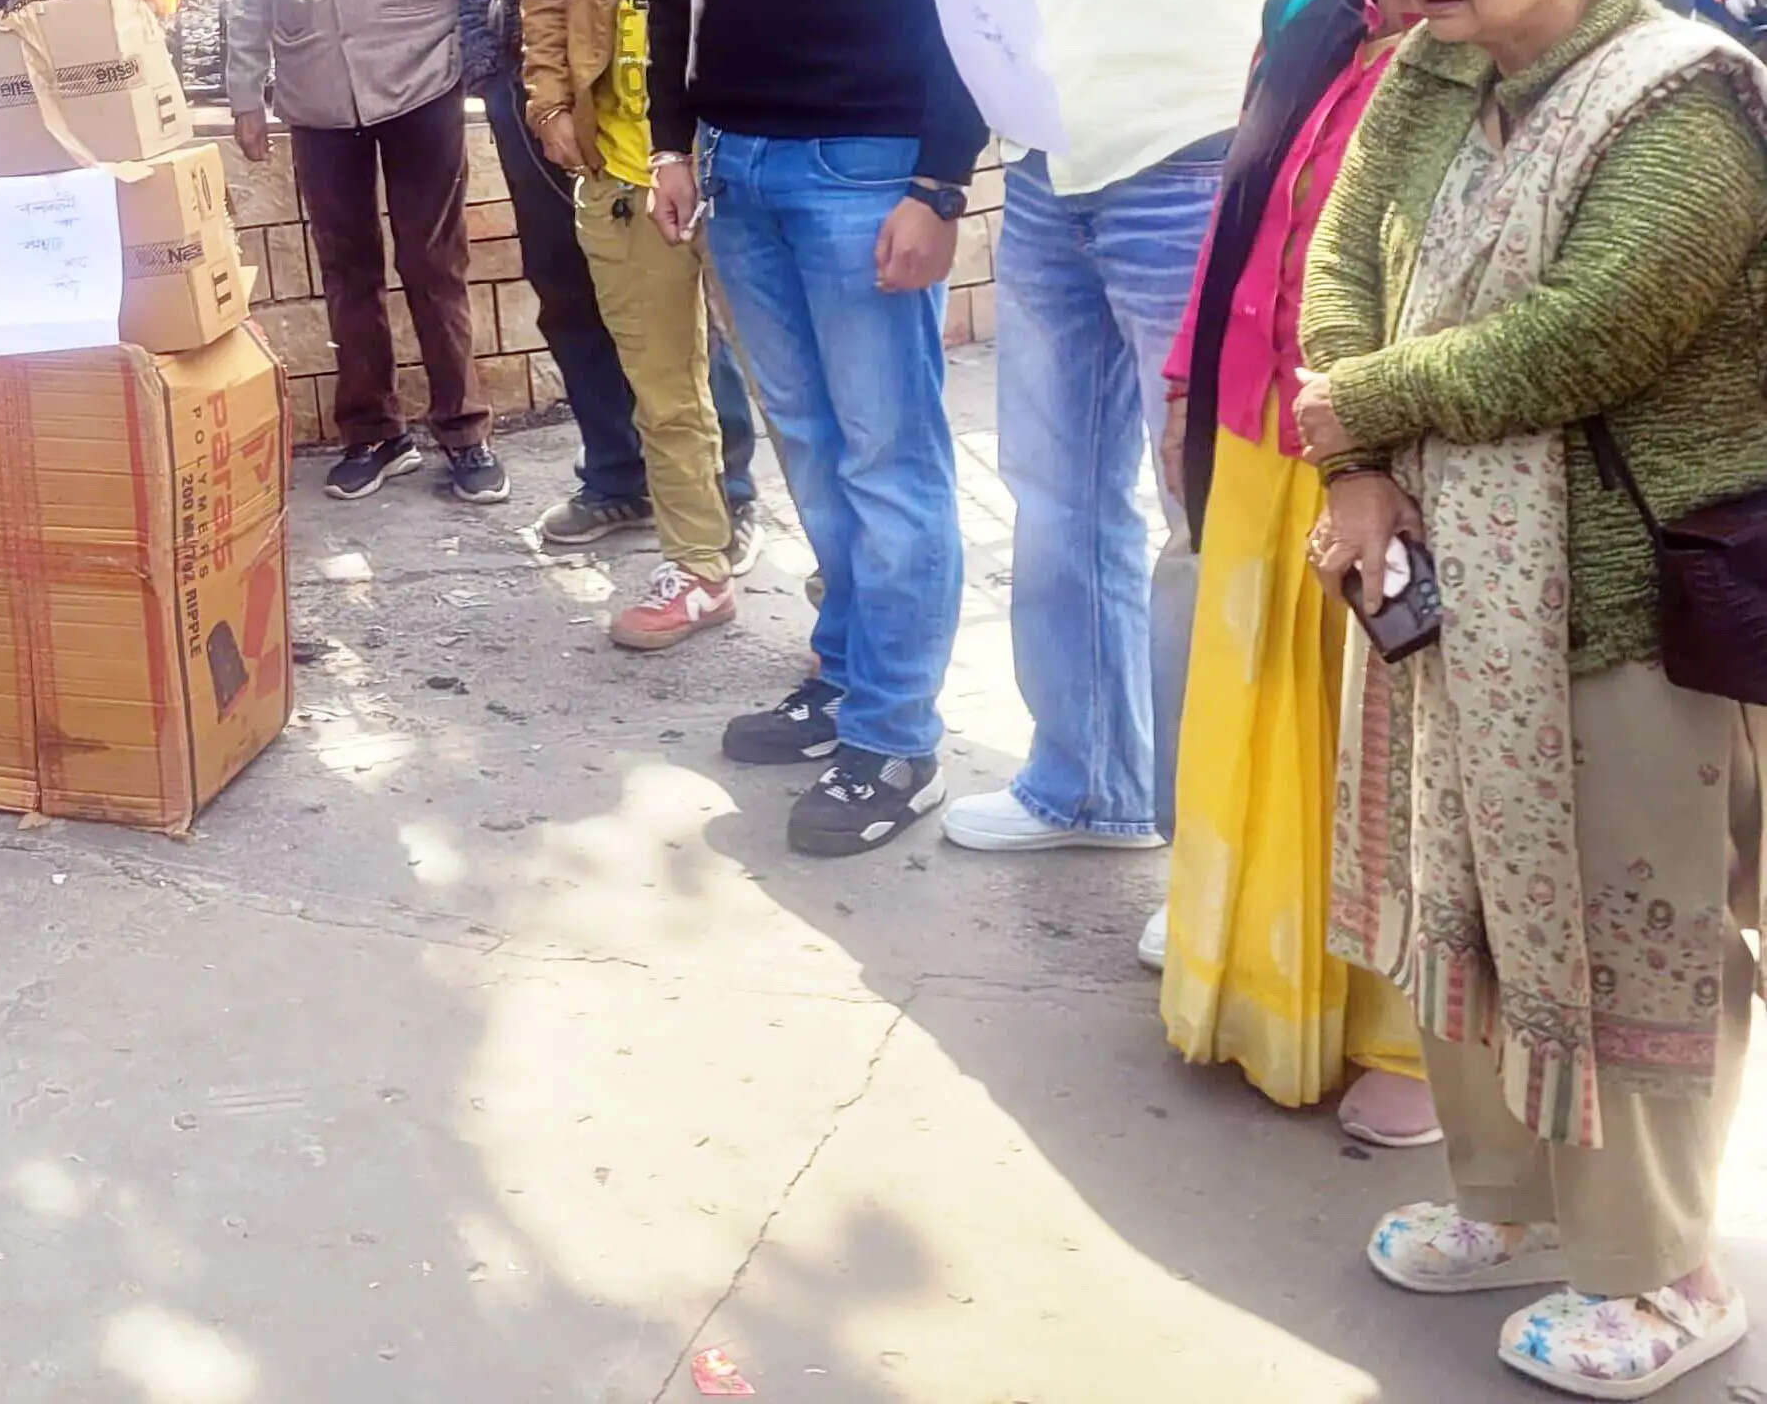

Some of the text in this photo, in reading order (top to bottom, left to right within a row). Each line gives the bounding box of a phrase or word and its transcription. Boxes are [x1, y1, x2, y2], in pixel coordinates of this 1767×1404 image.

[181, 473, 194, 511] 200
[191, 405, 210, 580] POLYMERS
[185, 587, 202, 660] RIPPLE
